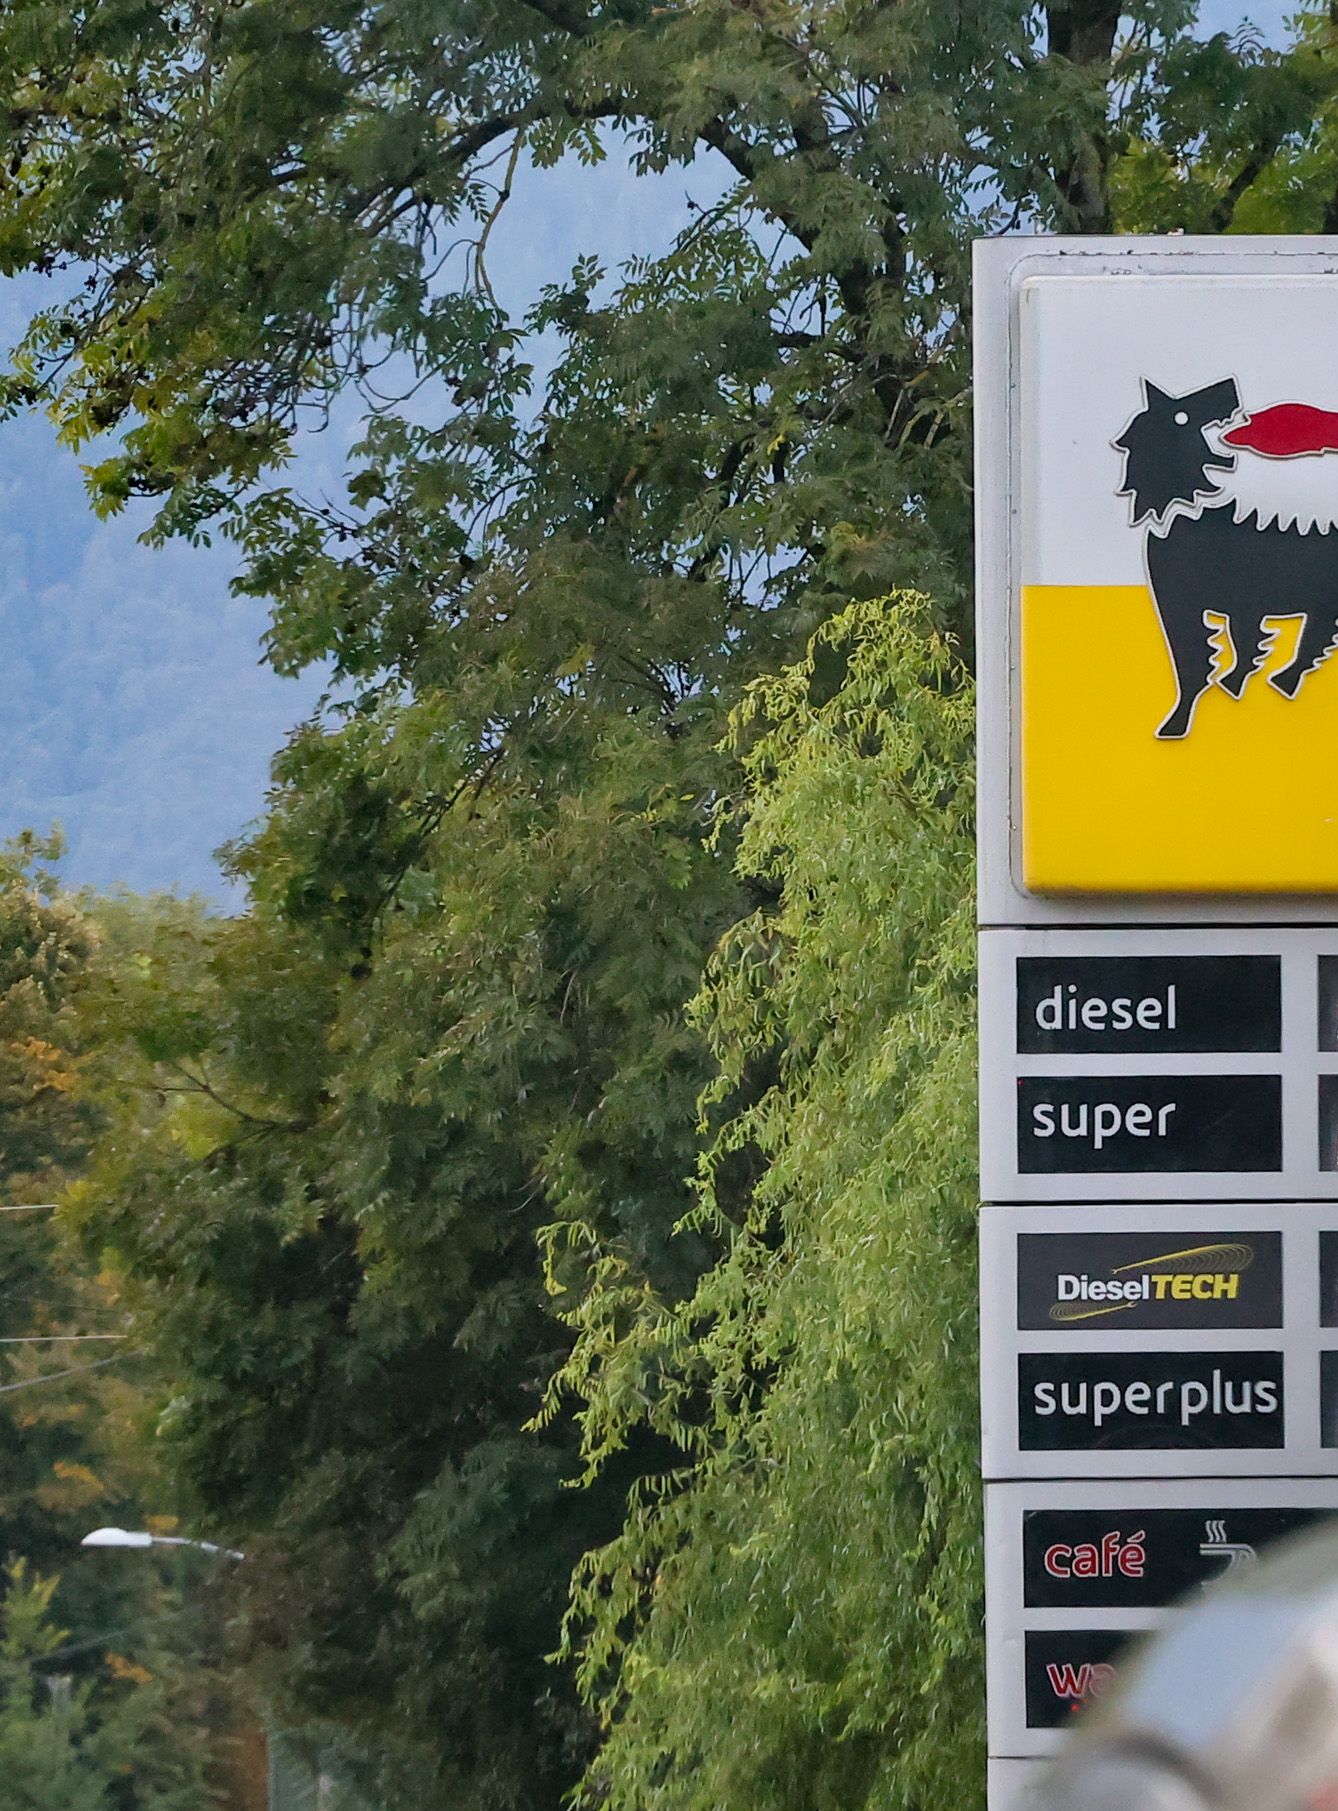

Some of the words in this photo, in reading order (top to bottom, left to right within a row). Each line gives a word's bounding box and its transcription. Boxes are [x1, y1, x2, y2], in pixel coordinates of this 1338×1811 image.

[1036, 985, 1175, 1030] diesel
[1033, 1103, 1175, 1149] super
[1058, 1274, 1238, 1300] DieselTECH
[1045, 1530, 1145, 1577] café
